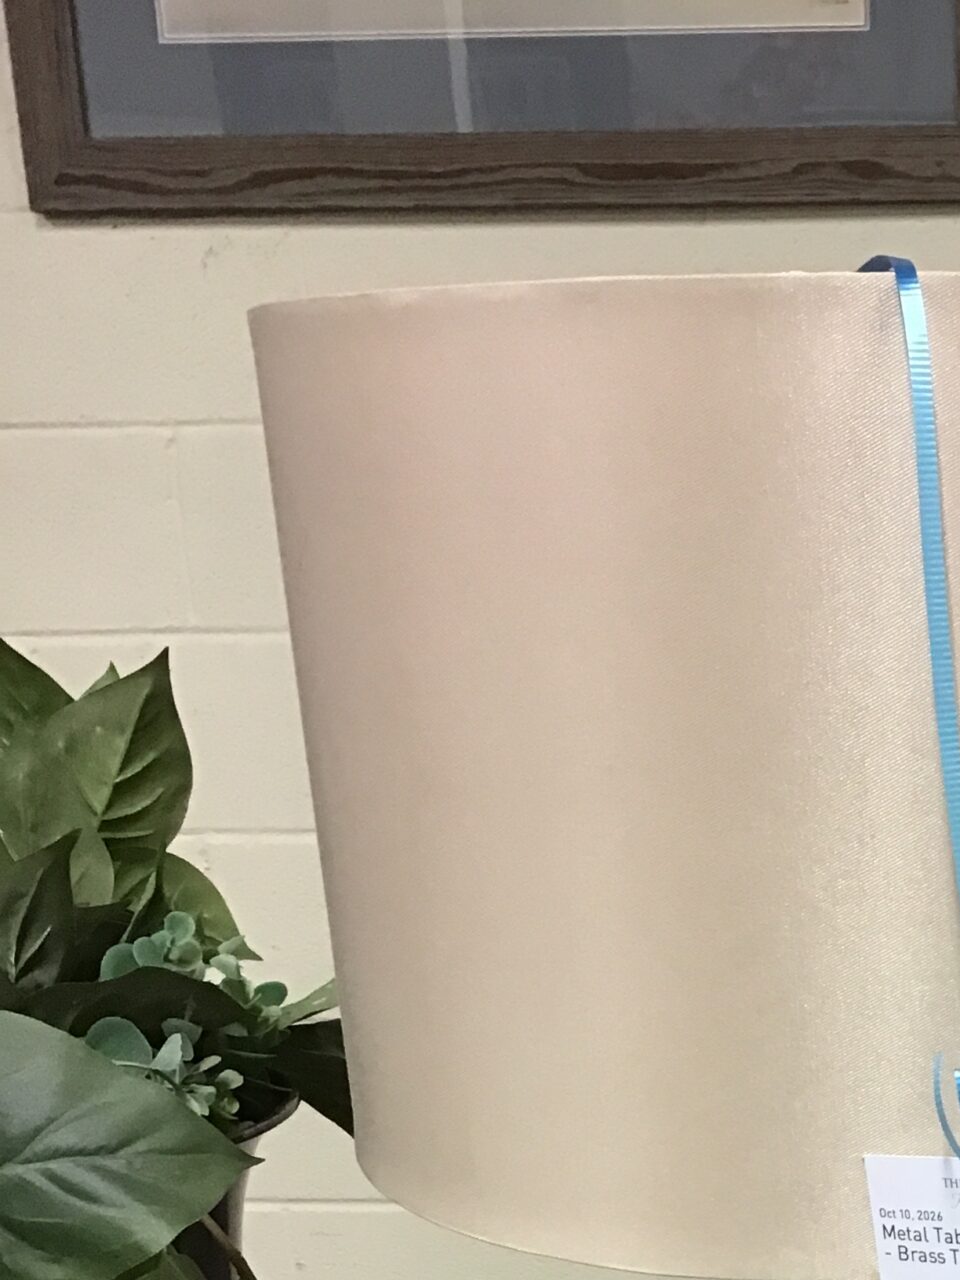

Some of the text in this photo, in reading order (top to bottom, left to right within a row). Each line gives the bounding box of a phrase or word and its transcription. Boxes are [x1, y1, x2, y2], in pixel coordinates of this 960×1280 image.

[879, 1207, 943, 1222] Oct 10, 2026
[882, 1223, 929, 1243] Metal
[897, 1245, 946, 1265] Brass
